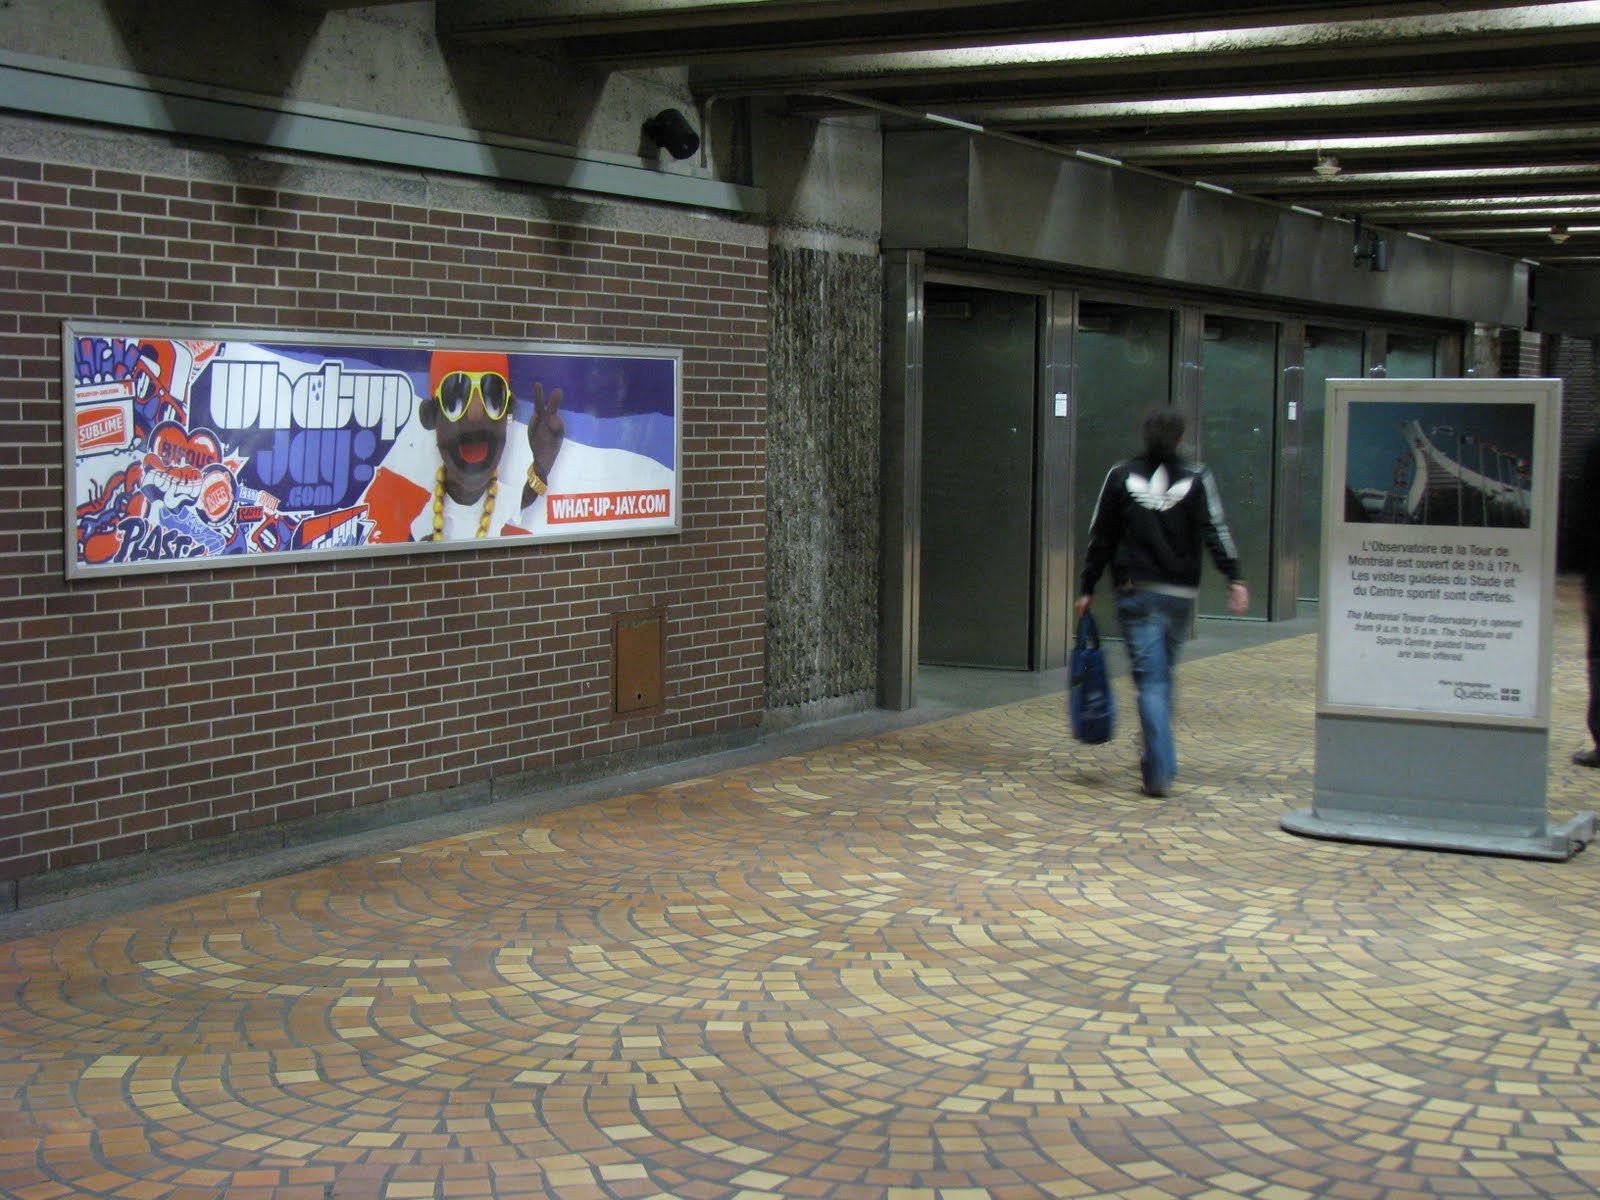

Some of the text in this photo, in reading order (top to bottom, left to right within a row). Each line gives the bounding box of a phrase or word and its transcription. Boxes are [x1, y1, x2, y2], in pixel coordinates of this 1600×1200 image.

[79, 416, 123, 441] SUBLIME
[552, 494, 665, 519] WHAT-UP-JAY.COM
[1362, 541, 1509, 557] L'Observatoire de la Tour de
[1348, 555, 1393, 568] Montréal
[1396, 559, 1412, 568] est
[1415, 559, 1449, 570] ouvert
[1452, 560, 1465, 570] de
[1352, 570, 1515, 587] Les visites guidées du Stade et
[1353, 585, 1515, 603] du Centre sportif sont offertes.
[1347, 610, 1362, 620] The
[1402, 613, 1426, 623] Tower
[1428, 614, 1478, 627] Observatory
[1354, 623, 1374, 632] from
[1403, 625, 1412, 634] to
[1442, 627, 1457, 637] The
[1459, 628, 1493, 638] Stadium
[1376, 636, 1402, 647] Sports
[1454, 687, 1498, 701] Québec
